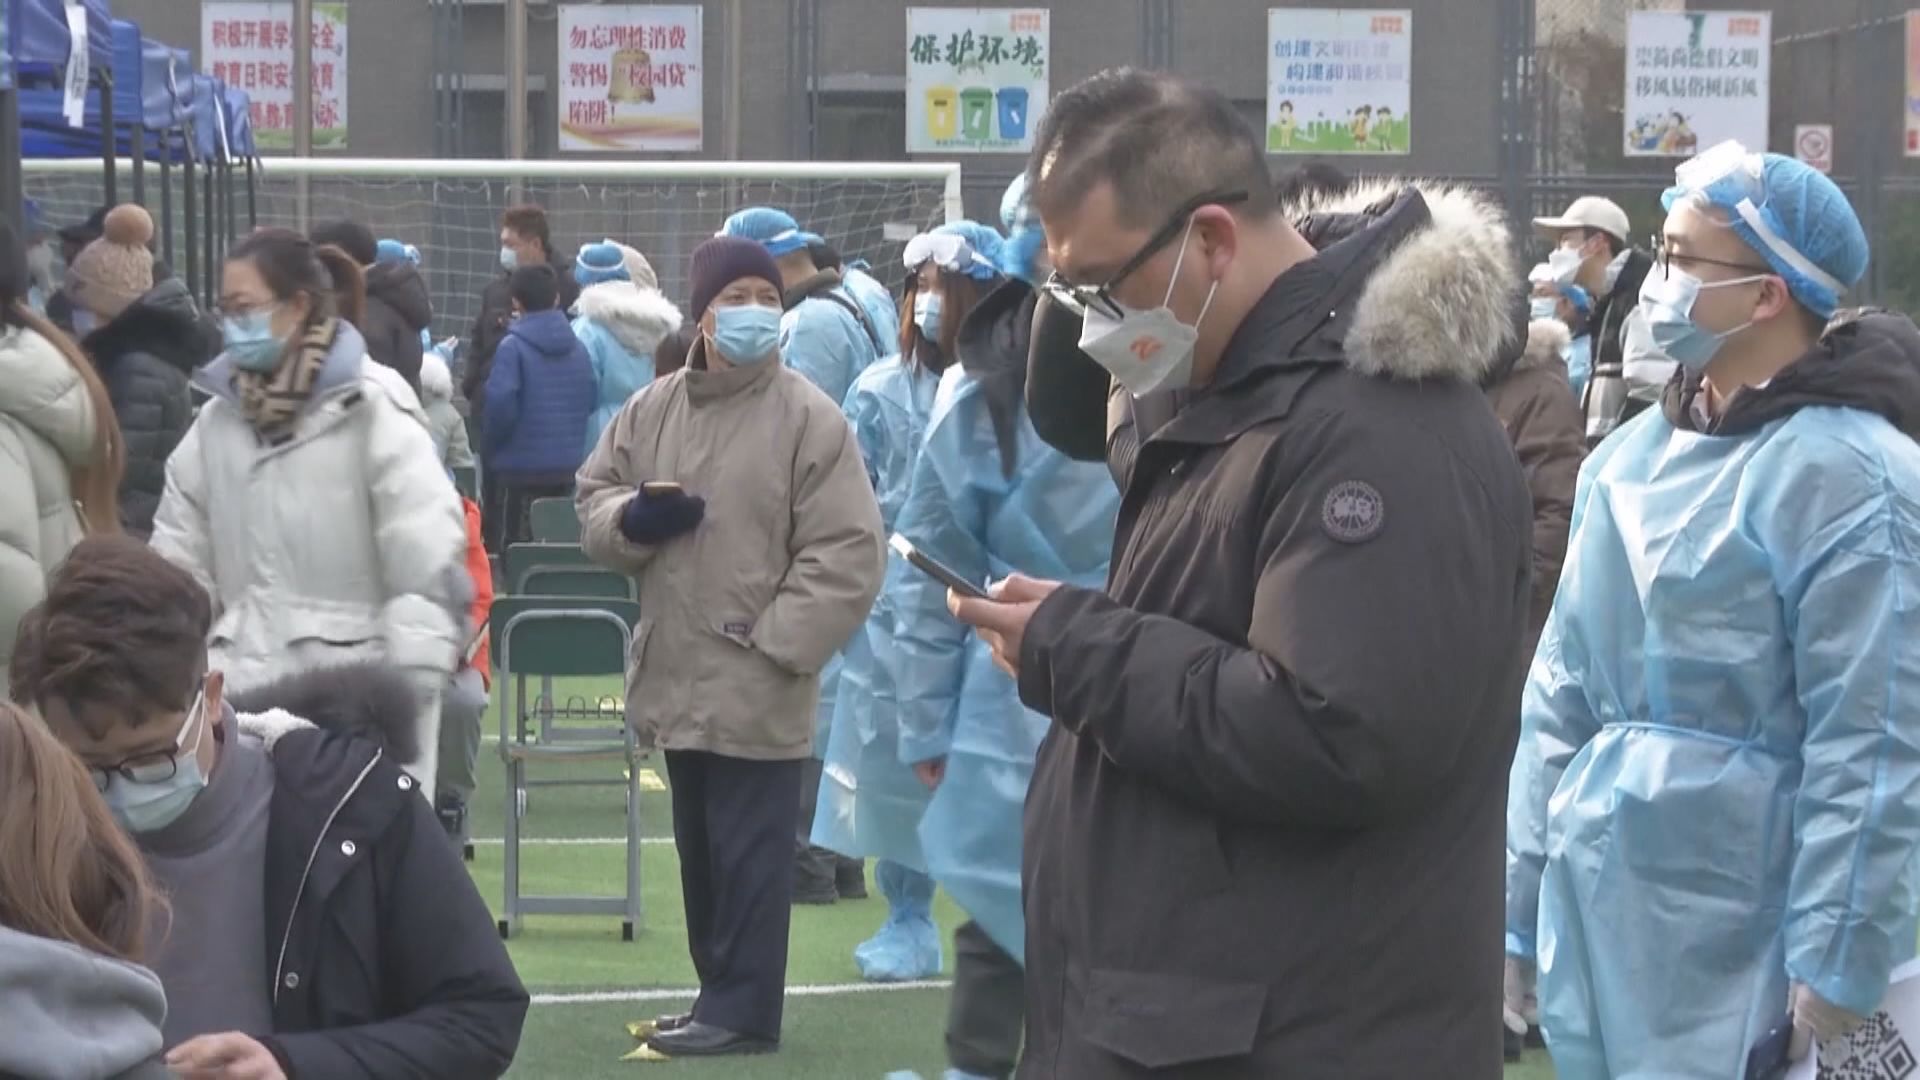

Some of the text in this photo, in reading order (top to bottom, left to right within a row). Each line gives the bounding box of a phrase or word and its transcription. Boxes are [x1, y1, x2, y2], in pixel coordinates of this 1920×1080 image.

[212, 20, 334, 49] 积极开展学安全
[569, 25, 686, 50] 勿忘理性消费
[910, 28, 1044, 66] 保护环境
[213, 62, 334, 90] 教育日和安教育
[1635, 76, 1758, 98] 移风易俗树新风
